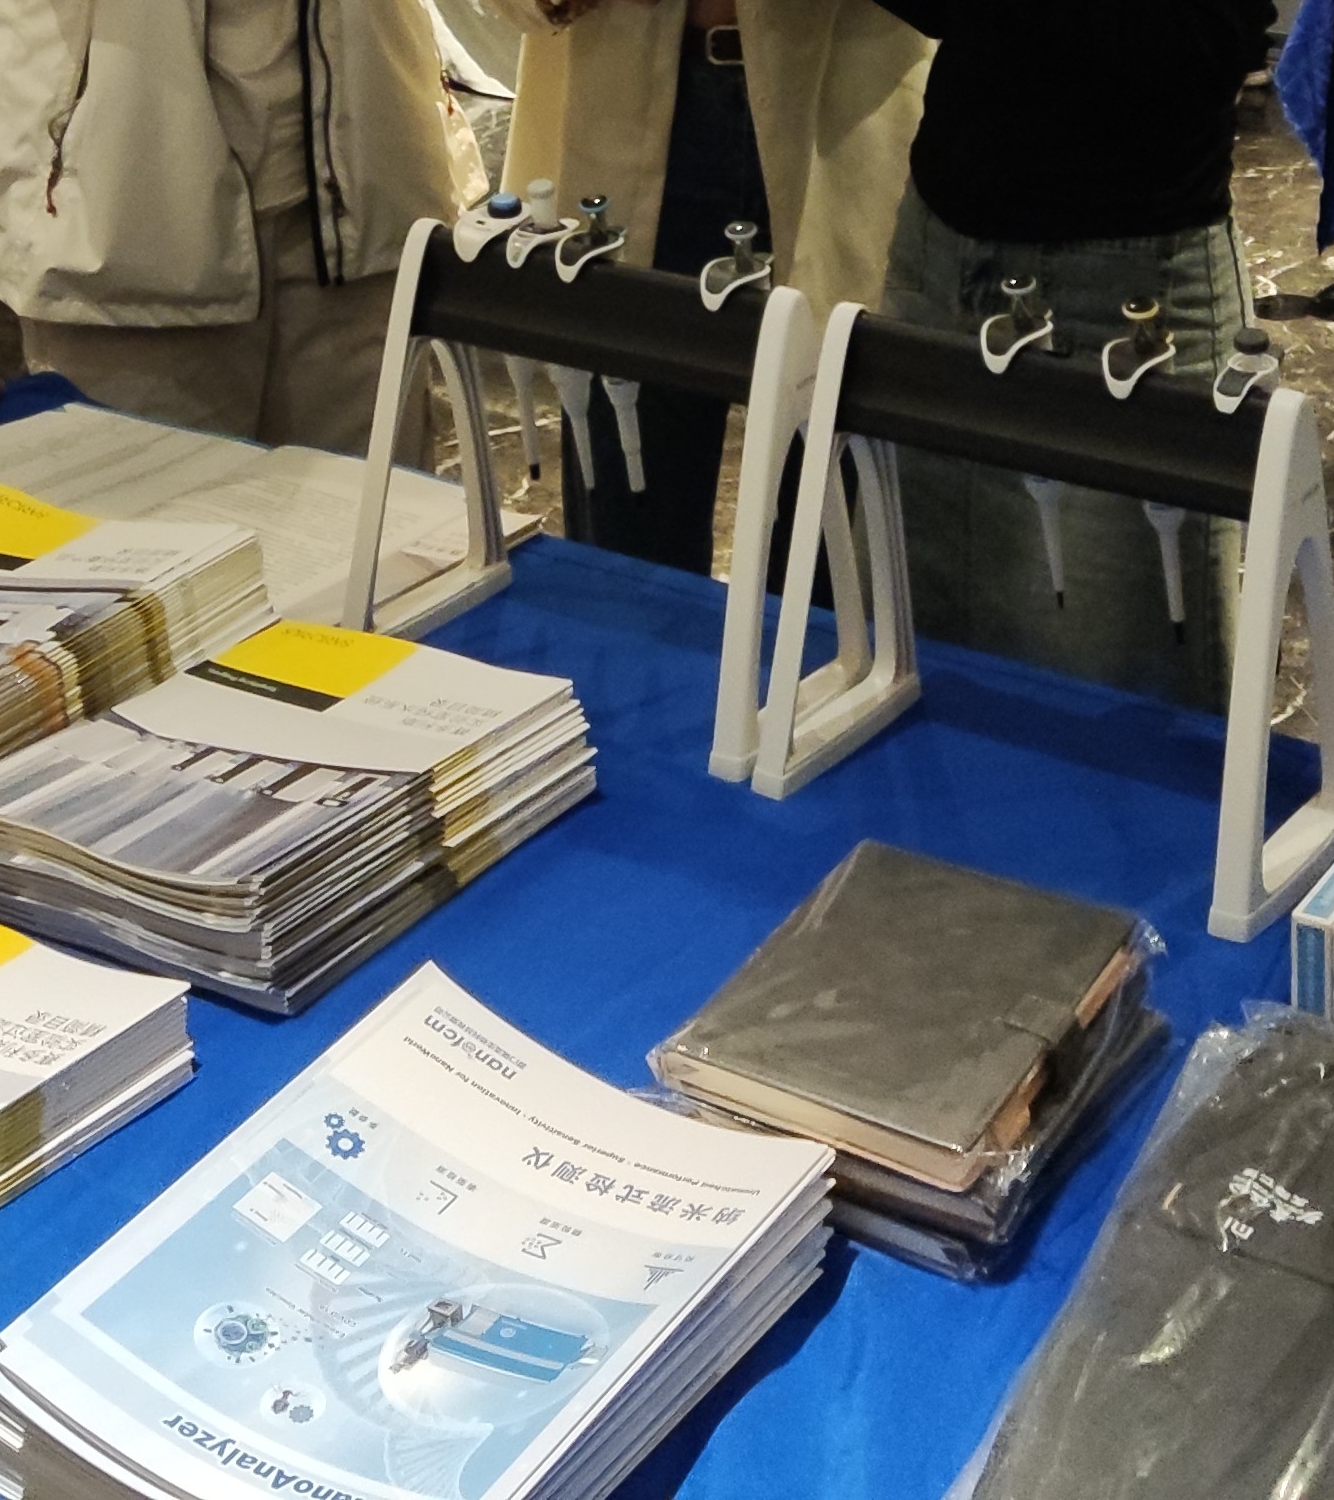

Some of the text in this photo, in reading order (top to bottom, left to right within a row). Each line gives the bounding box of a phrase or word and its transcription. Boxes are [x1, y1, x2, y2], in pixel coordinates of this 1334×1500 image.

[455, 1071, 470, 1083] for
[470, 1081, 522, 1116] Innovation
[528, 1115, 581, 1146] Sensitivity
[582, 1142, 626, 1164] Superior
[521, 1146, 746, 1226] 纳米流式检测仪
[163, 1414, 364, 1500] anoAnalyzer
